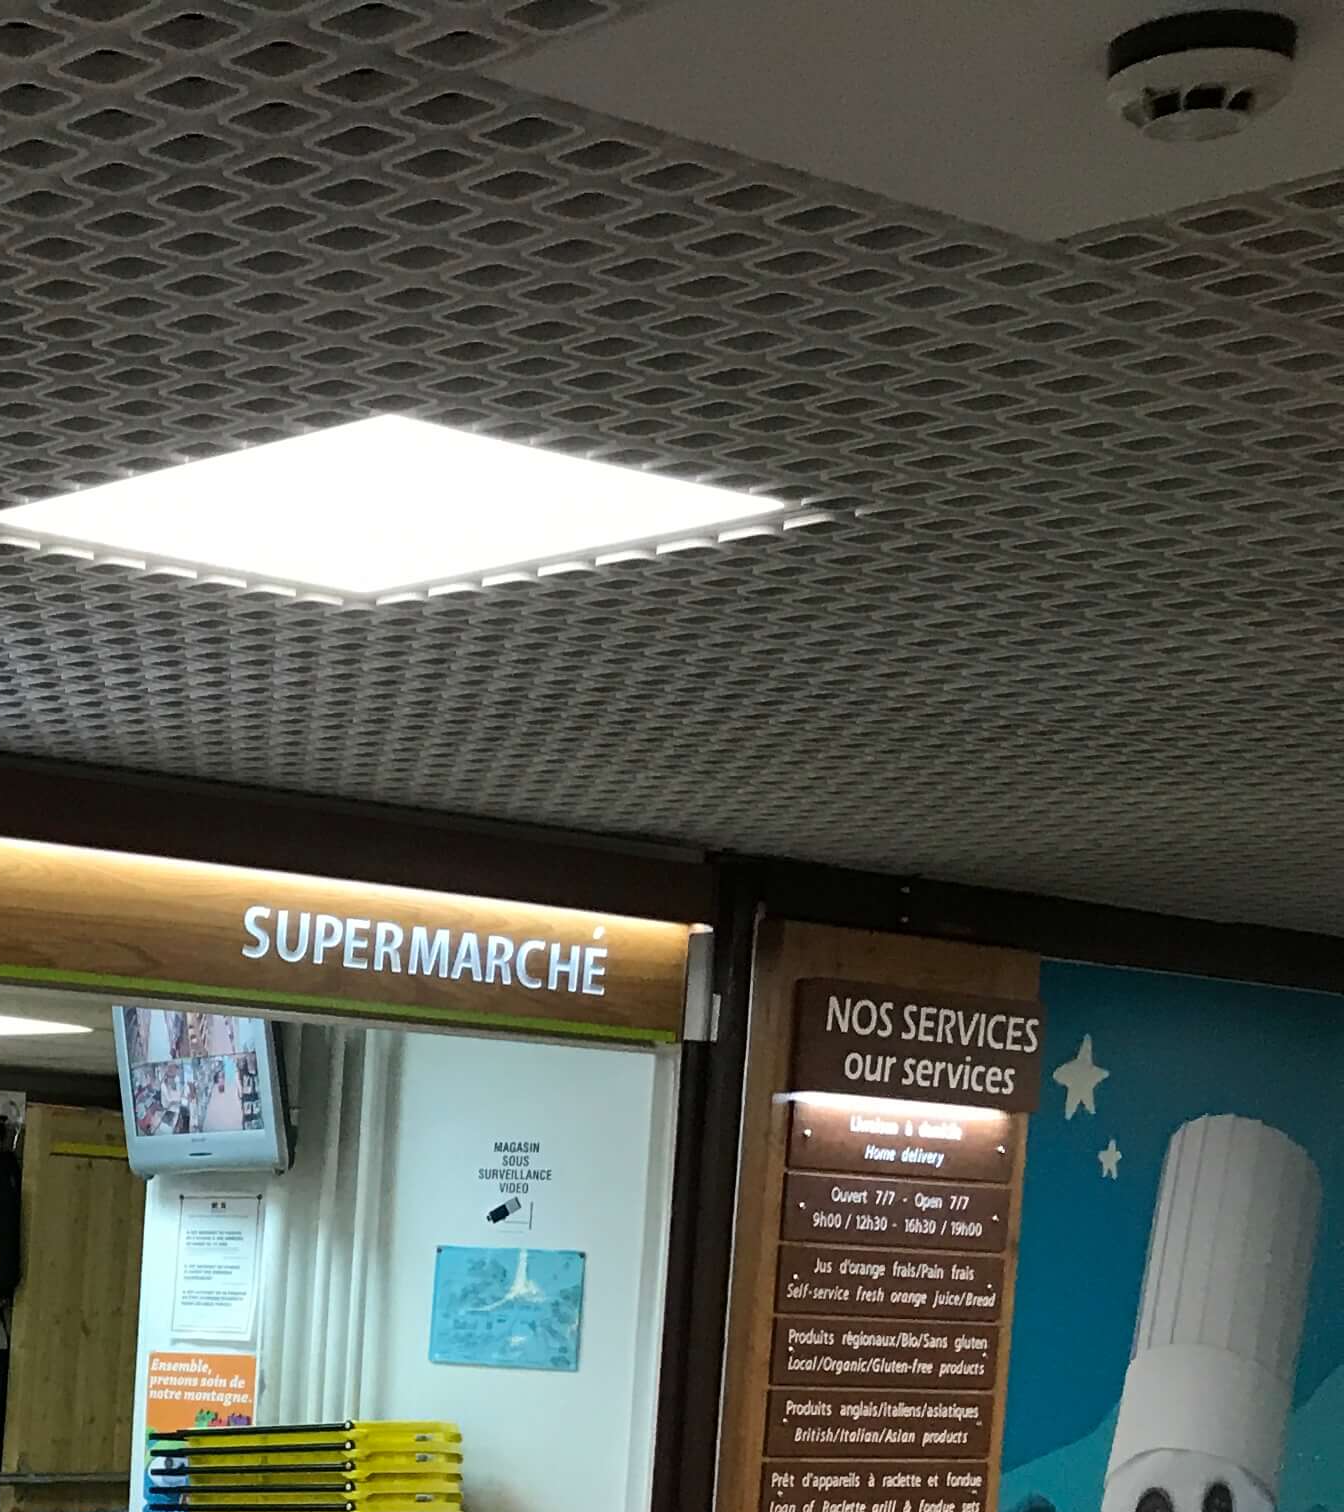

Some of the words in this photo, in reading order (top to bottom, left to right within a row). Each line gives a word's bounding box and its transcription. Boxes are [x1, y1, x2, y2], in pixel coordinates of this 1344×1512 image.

[241, 905, 609, 996] SUPERMARCHÉ
[826, 996, 894, 1037] NOS
[901, 1004, 1040, 1053] SERVICES
[844, 1052, 896, 1083] our
[901, 1056, 1016, 1095] services
[493, 1142, 540, 1153] MAGASIN
[864, 1144, 895, 1163] Home
[901, 1146, 945, 1168] delivery
[502, 1155, 530, 1167] SOUS
[478, 1168, 552, 1181] SURVEILLANCE
[499, 1182, 529, 1194] VIDEO
[831, 1186, 868, 1205] Ouvert
[875, 1190, 895, 1206] 7/7
[914, 1192, 943, 1211] Open
[949, 1195, 969, 1211] 7/7
[812, 1211, 842, 1229] 9h00
[855, 1214, 888, 1232] 12h30
[904, 1217, 936, 1234] 16h30
[951, 1221, 983, 1237] 19h00
[814, 1258, 832, 1275] Jus
[839, 1259, 886, 1280] d'orange
[892, 1261, 944, 1280] frais/Pain
[951, 1264, 975, 1281] frais
[786, 1283, 850, 1301] Self-service
[855, 1286, 885, 1303] fresh
[890, 1290, 927, 1308] orange
[932, 1290, 996, 1309] juice/Bread
[788, 1328, 835, 1346] Produits
[954, 1334, 988, 1352] gluten
[151, 1358, 212, 1375] Ensemble,
[788, 1355, 934, 1376] Local/Organic/Gluten-free
[938, 1360, 985, 1377] products
[149, 1374, 199, 1389] prenons
[199, 1374, 227, 1388] soin
[229, 1374, 246, 1389] de
[149, 1387, 182, 1400] notre
[785, 1399, 833, 1417] Produits
[839, 1400, 980, 1421] anglais/italiens/asiatiques
[794, 1426, 916, 1444] British/Italian/Asian
[921, 1428, 969, 1448] products
[770, 1471, 795, 1488] Prêt
[801, 1472, 861, 1491] d'appareils
[867, 1472, 875, 1488] à
[882, 1472, 922, 1488] raclette
[927, 1473, 938, 1488] et
[946, 1471, 983, 1488] fondue
